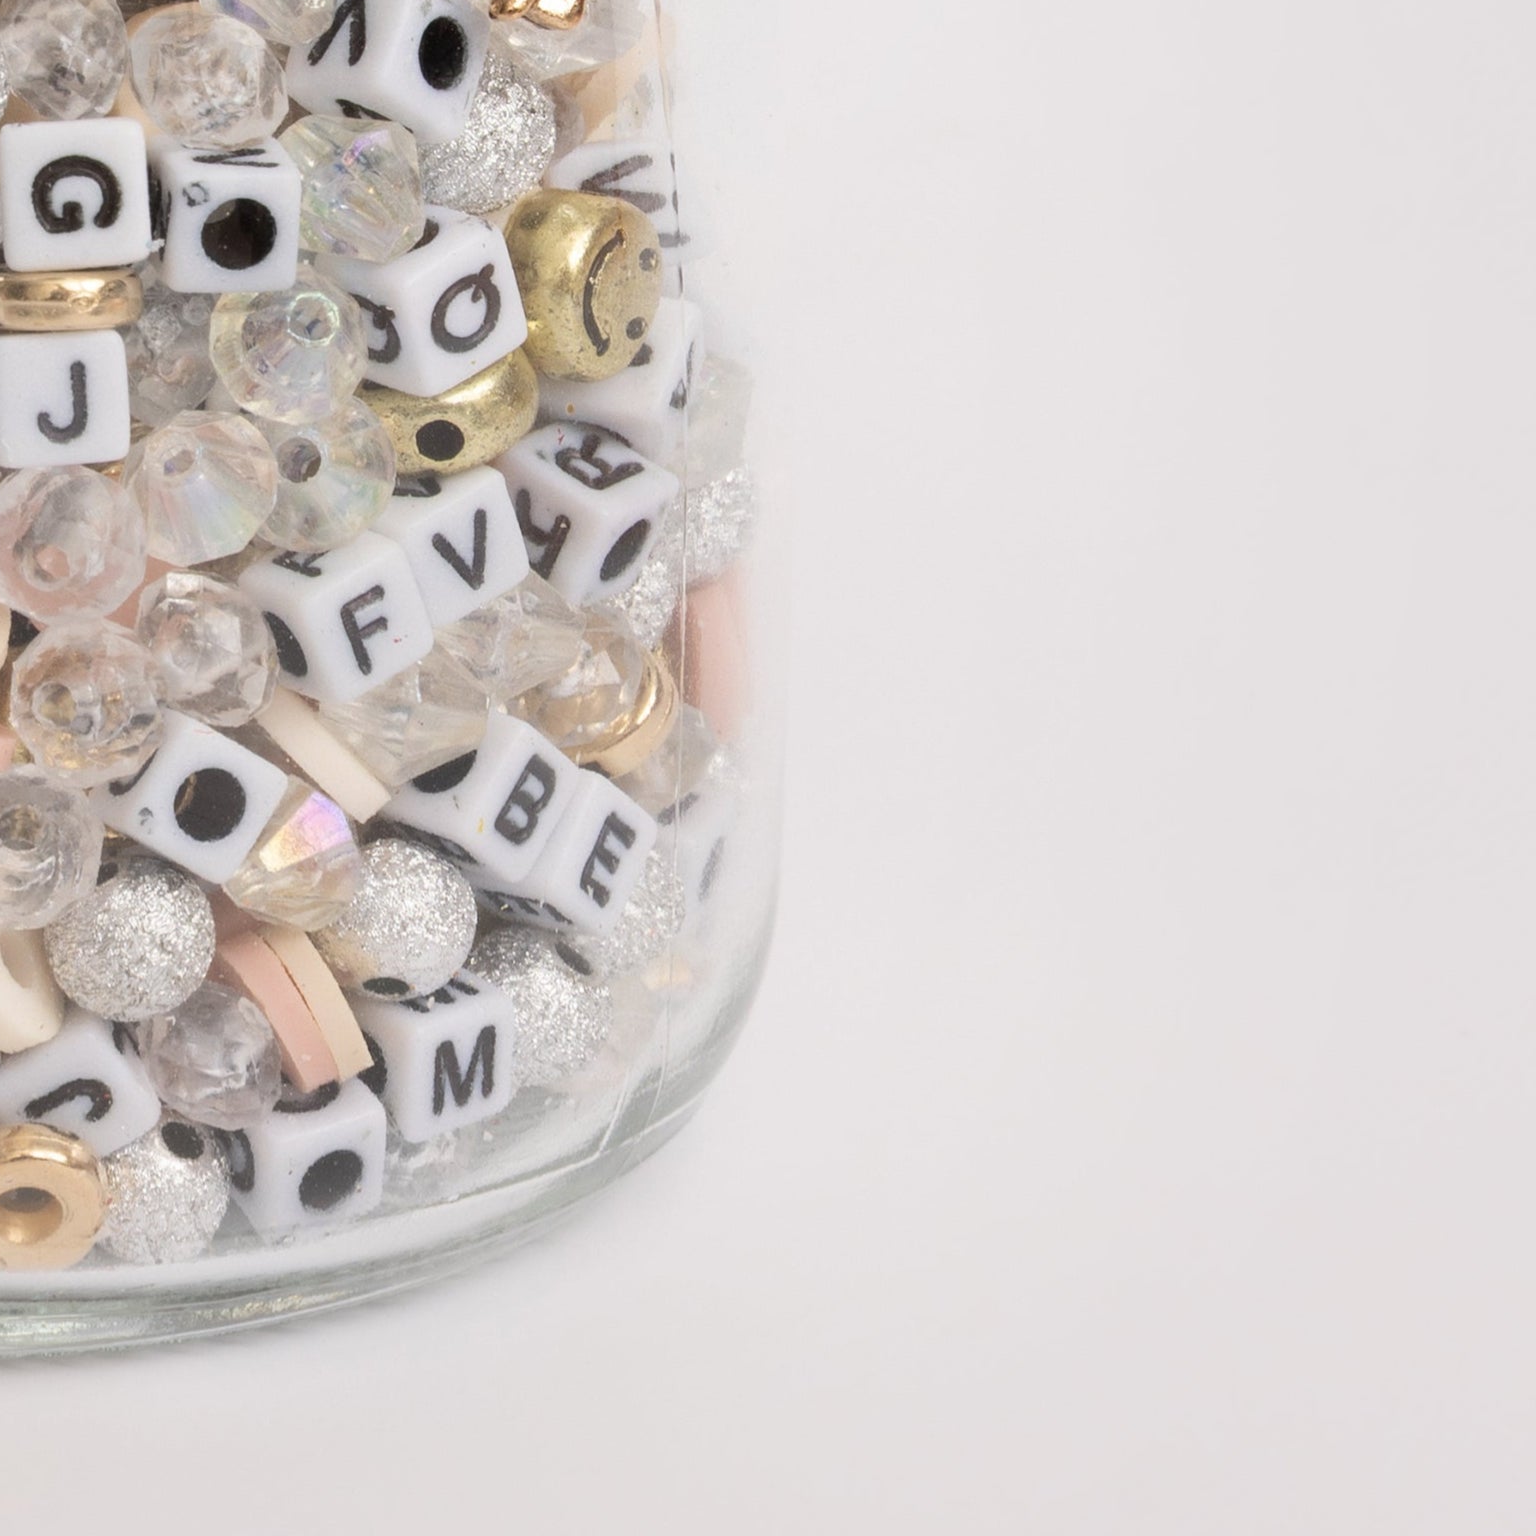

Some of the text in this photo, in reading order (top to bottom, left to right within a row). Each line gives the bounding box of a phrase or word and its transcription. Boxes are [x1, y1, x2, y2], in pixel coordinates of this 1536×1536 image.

[30, 154, 124, 235] G
[430, 262, 502, 355] Q
[36, 359, 89, 445] J
[431, 507, 487, 591] V
[339, 584, 390, 677] F
[494, 753, 558, 847] B
[578, 810, 638, 910] E
[432, 1024, 497, 1117] M
